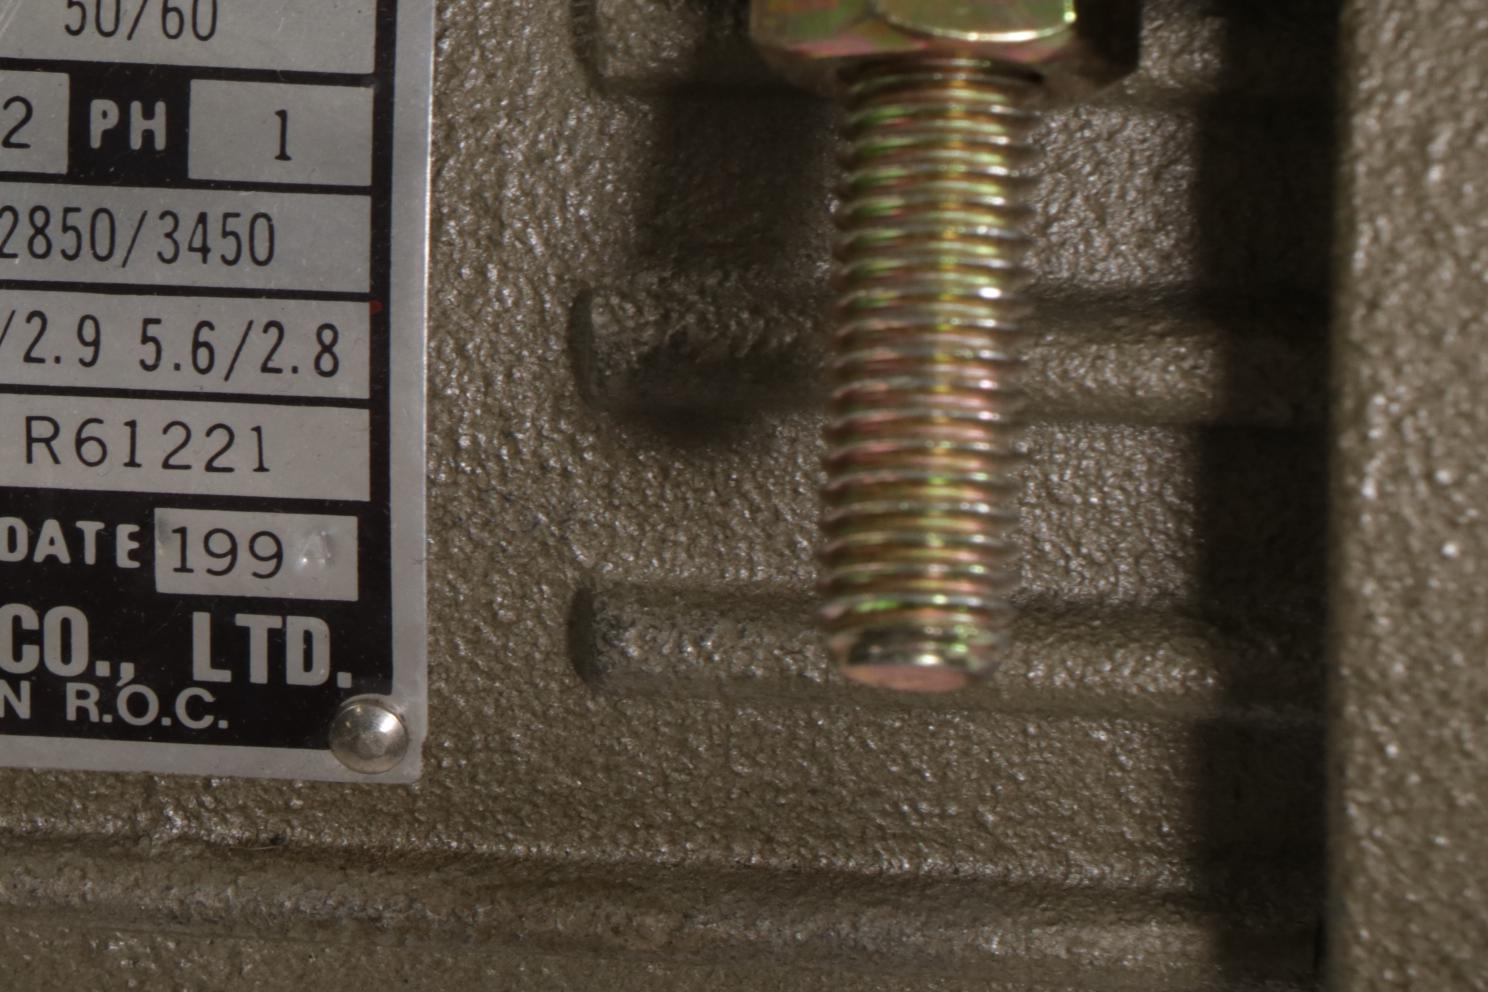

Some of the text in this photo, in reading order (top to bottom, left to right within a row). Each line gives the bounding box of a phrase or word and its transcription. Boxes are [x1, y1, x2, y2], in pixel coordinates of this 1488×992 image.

[90, 98, 168, 151] PH
[273, 110, 292, 162] 1
[139, 317, 341, 381] 5.6/2.8
[23, 415, 272, 474] R61221
[191, 611, 353, 689] LTD.
[66, 682, 229, 730] R.O.C.
